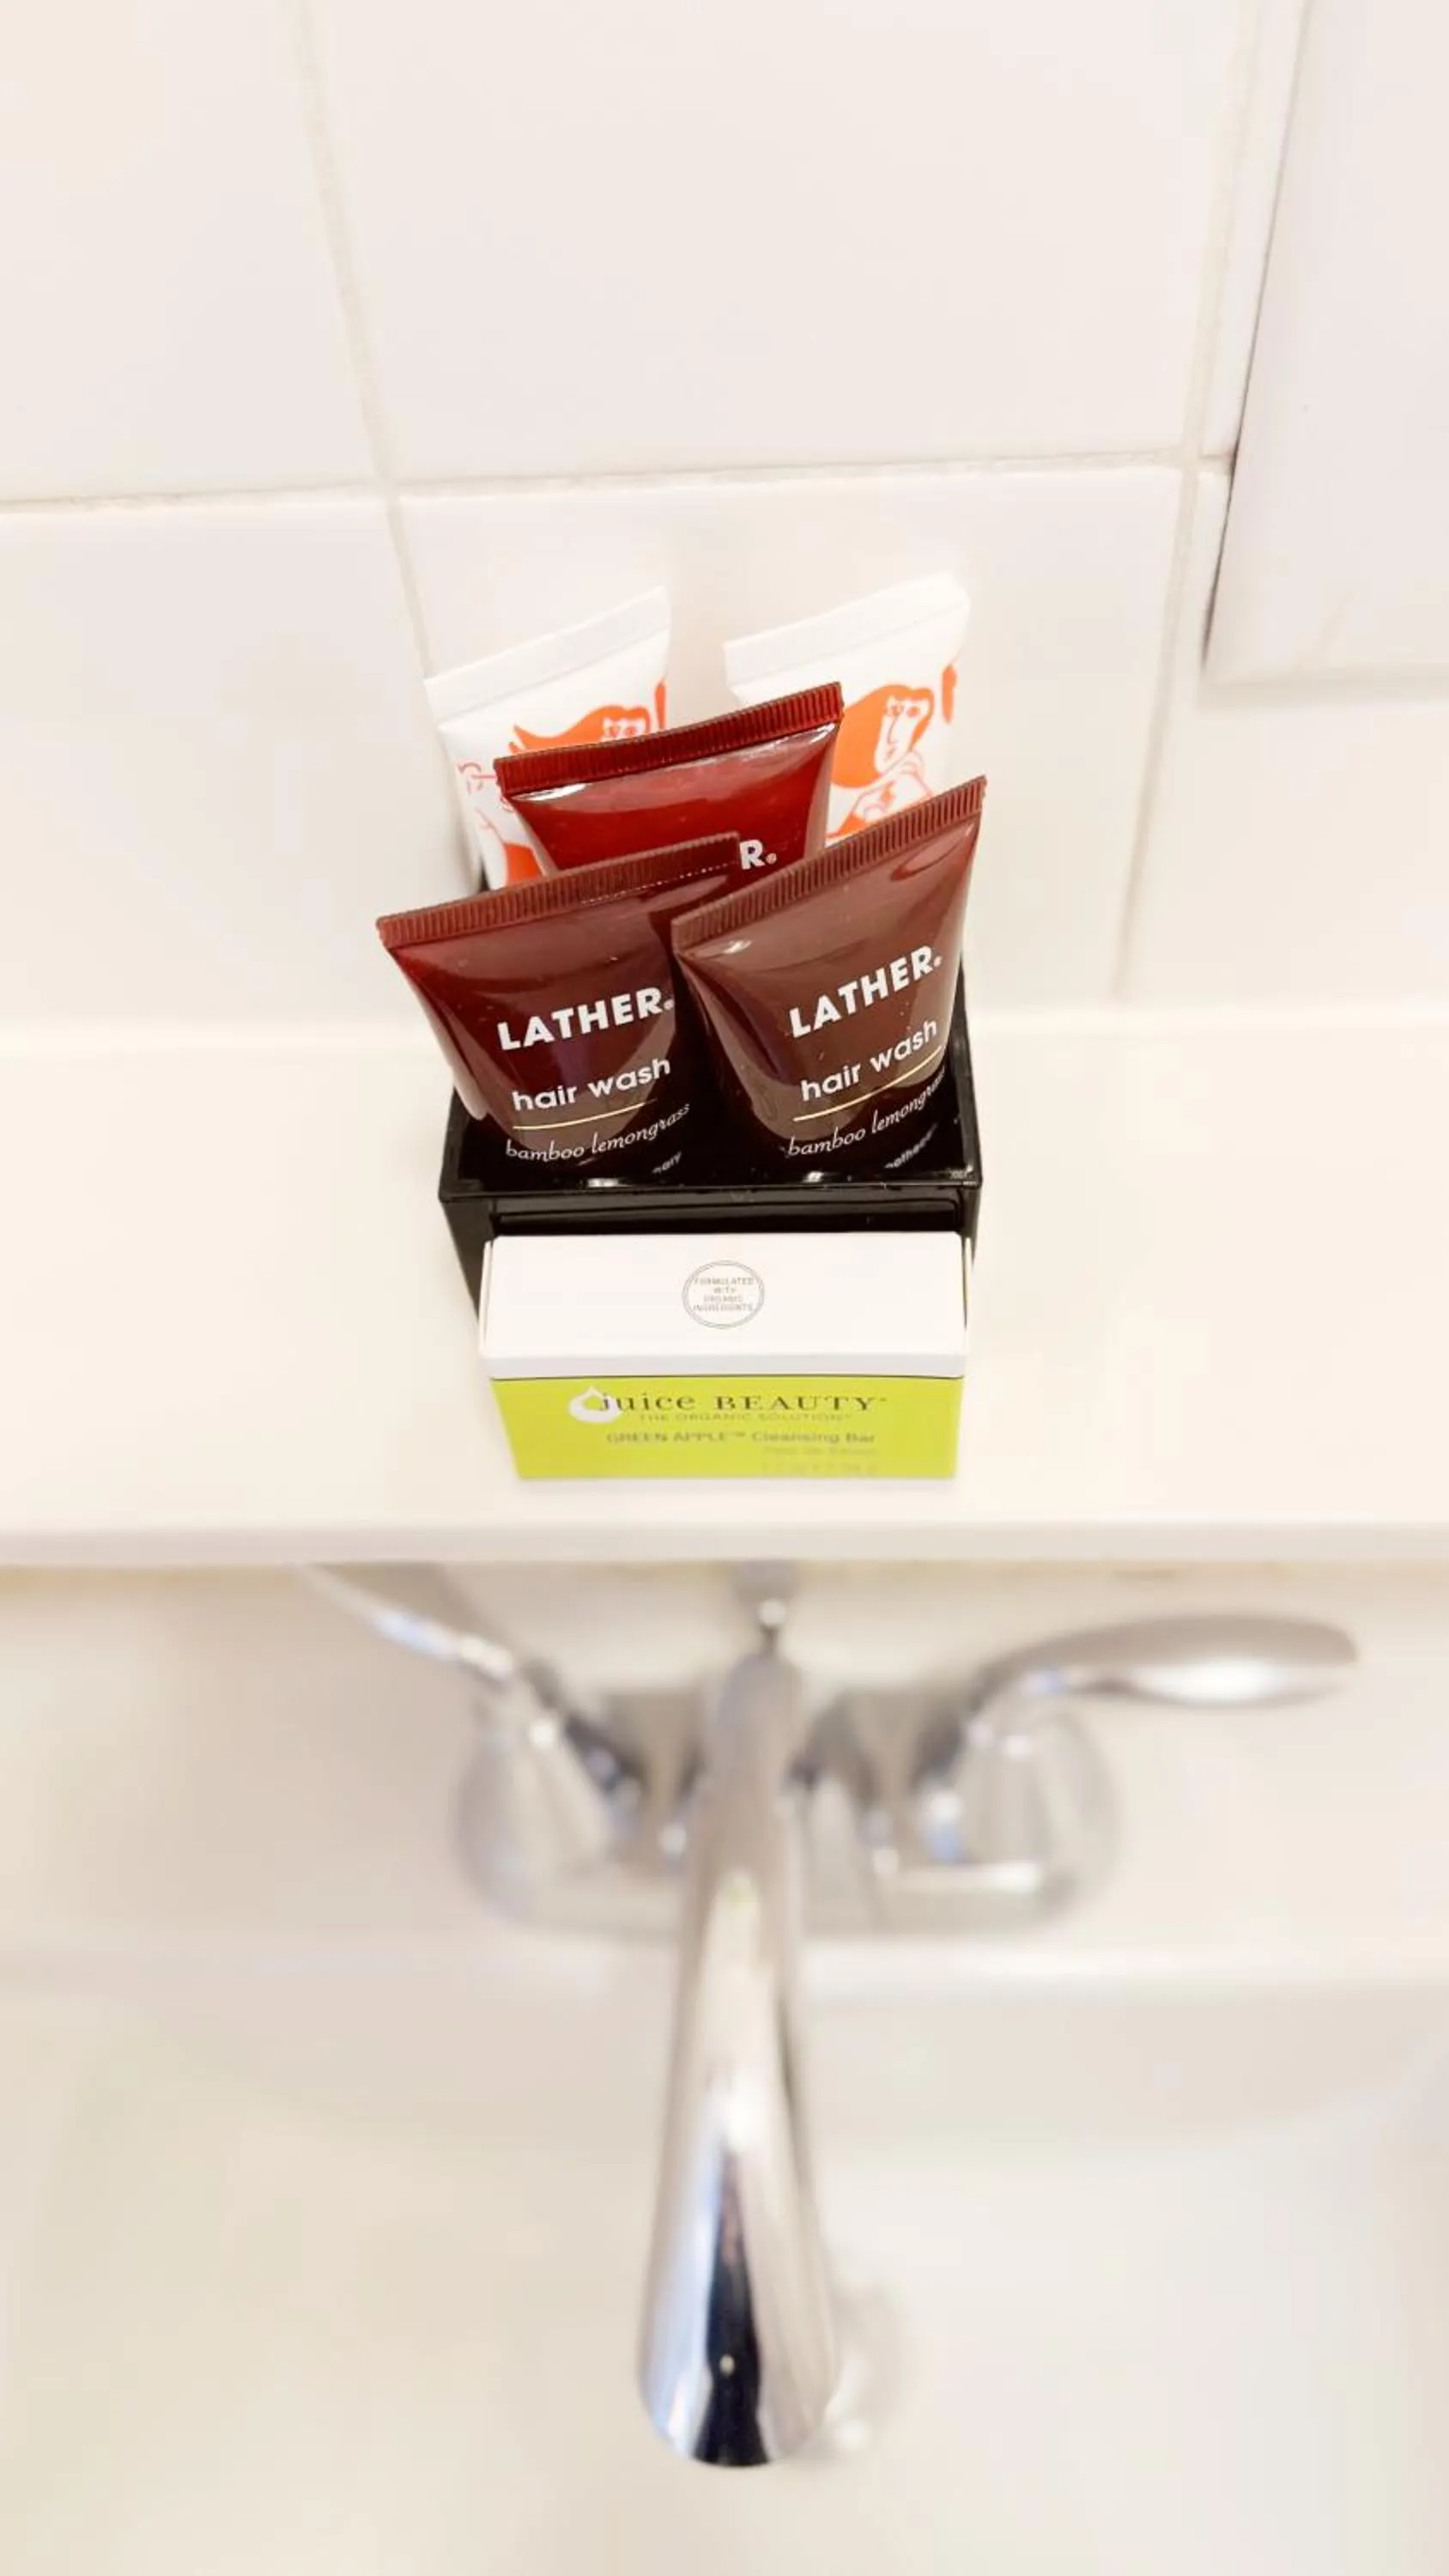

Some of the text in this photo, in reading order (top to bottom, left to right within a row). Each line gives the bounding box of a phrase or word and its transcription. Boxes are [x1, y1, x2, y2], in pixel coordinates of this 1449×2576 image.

[800, 1020, 937, 1102] hair wash
[512, 1058, 670, 1111] hair wash
[506, 1103, 690, 1162] bamboo lemongrass
[786, 1126, 866, 1157] bamboo
[598, 1393, 696, 1412] juice
[606, 1431, 669, 1443] GREEN
[751, 1431, 840, 1444] Cleansing
